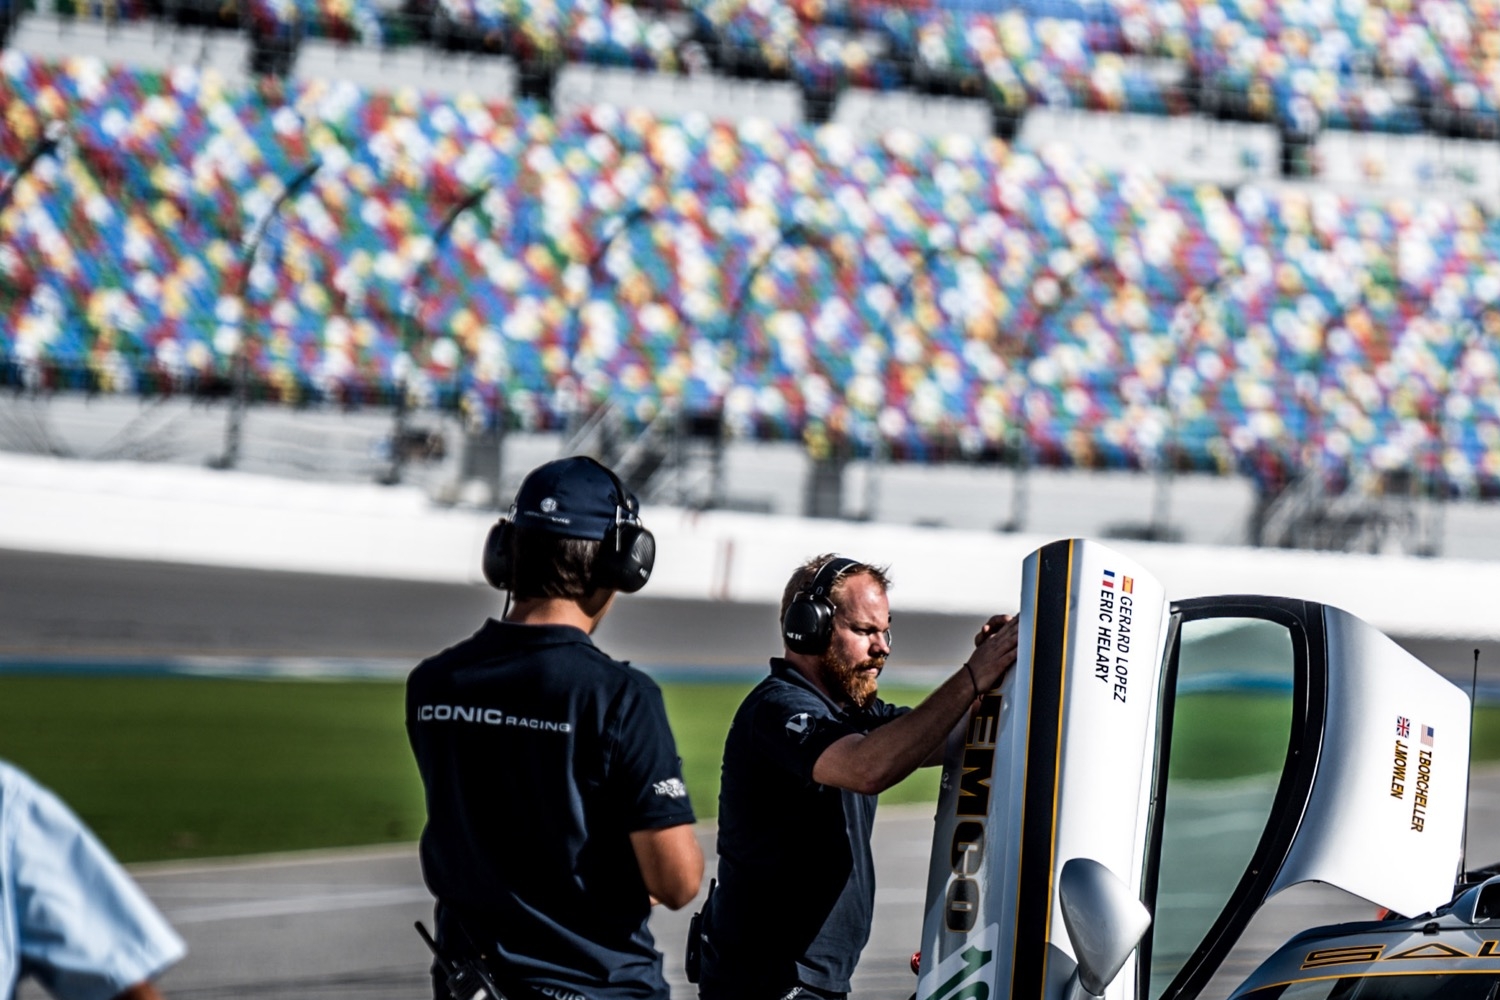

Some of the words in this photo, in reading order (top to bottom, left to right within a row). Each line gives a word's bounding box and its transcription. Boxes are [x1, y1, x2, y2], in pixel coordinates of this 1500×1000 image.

[1099, 589, 1115, 623] ERIC
[1117, 596, 1133, 654] GERARD
[1095, 626, 1112, 683] HELARY
[1113, 656, 1129, 704] LOPEZ
[418, 705, 503, 725] ICONIC
[505, 716, 572, 733] RACING
[1390, 740, 1408, 800] J.MOWLEN
[944, 688, 1004, 933] EMCO
